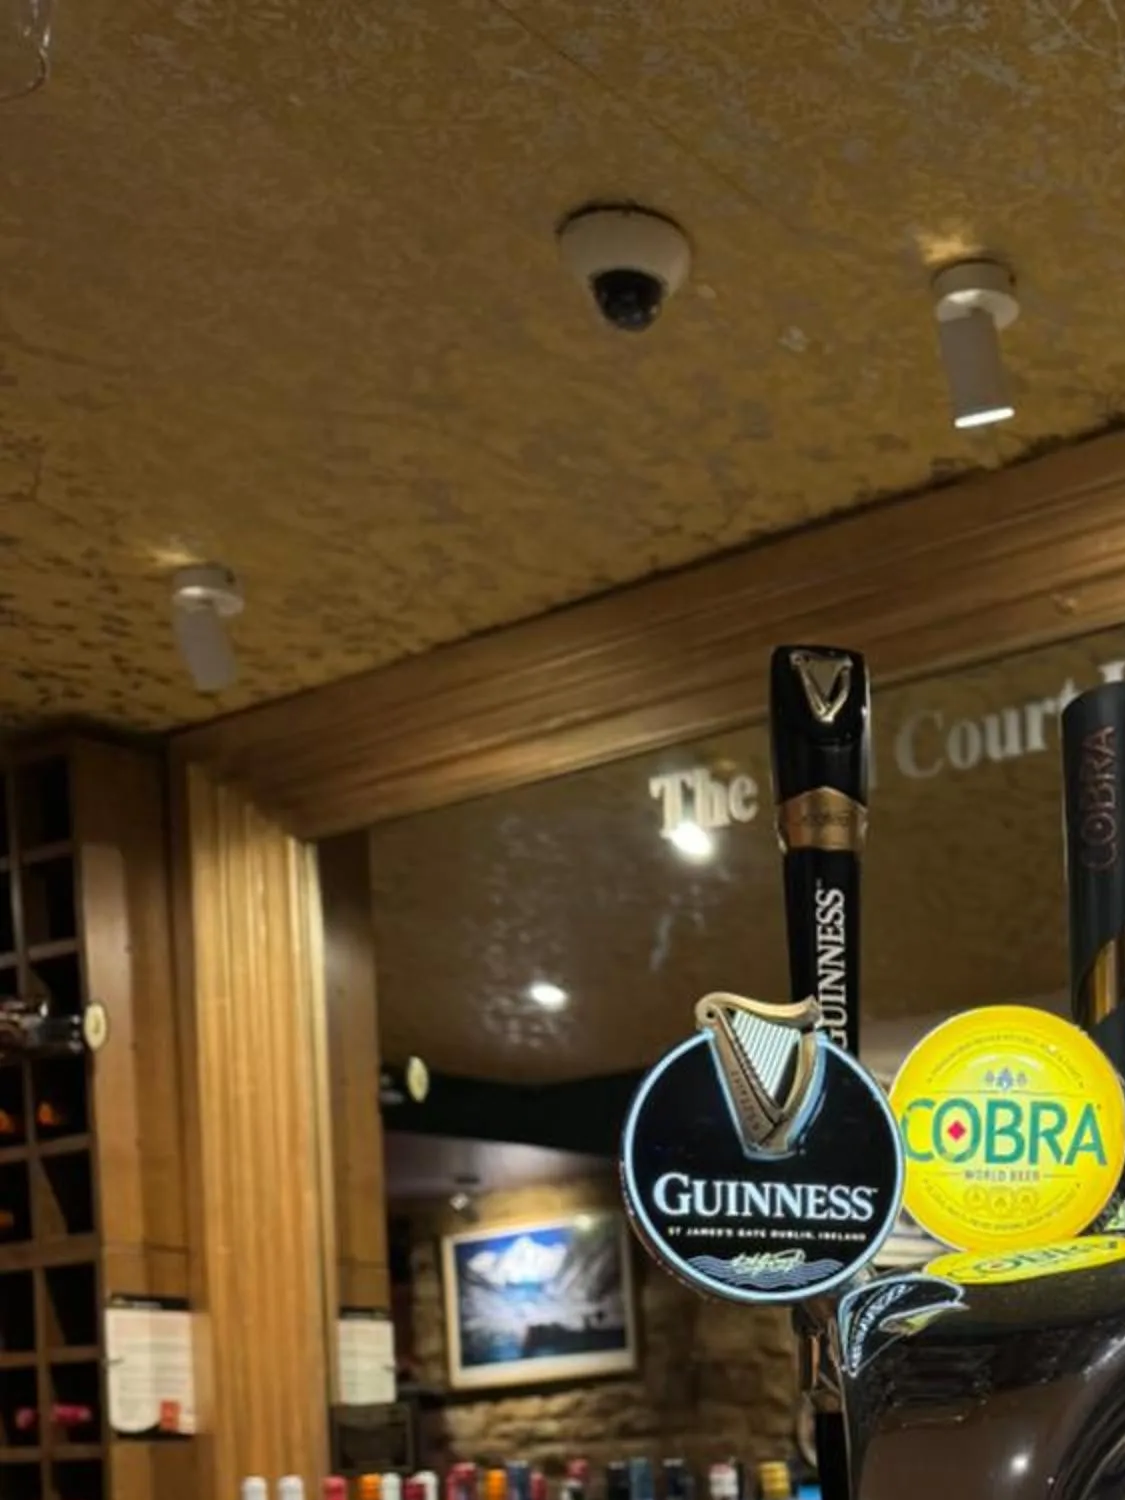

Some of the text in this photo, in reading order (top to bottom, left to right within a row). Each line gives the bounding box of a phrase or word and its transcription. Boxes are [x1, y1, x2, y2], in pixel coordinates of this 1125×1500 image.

[649, 766, 758, 840] The
[1082, 726, 1118, 870] COBRA
[901, 1098, 1108, 1166] COBRA
[653, 1172, 876, 1222] GUINNESS
